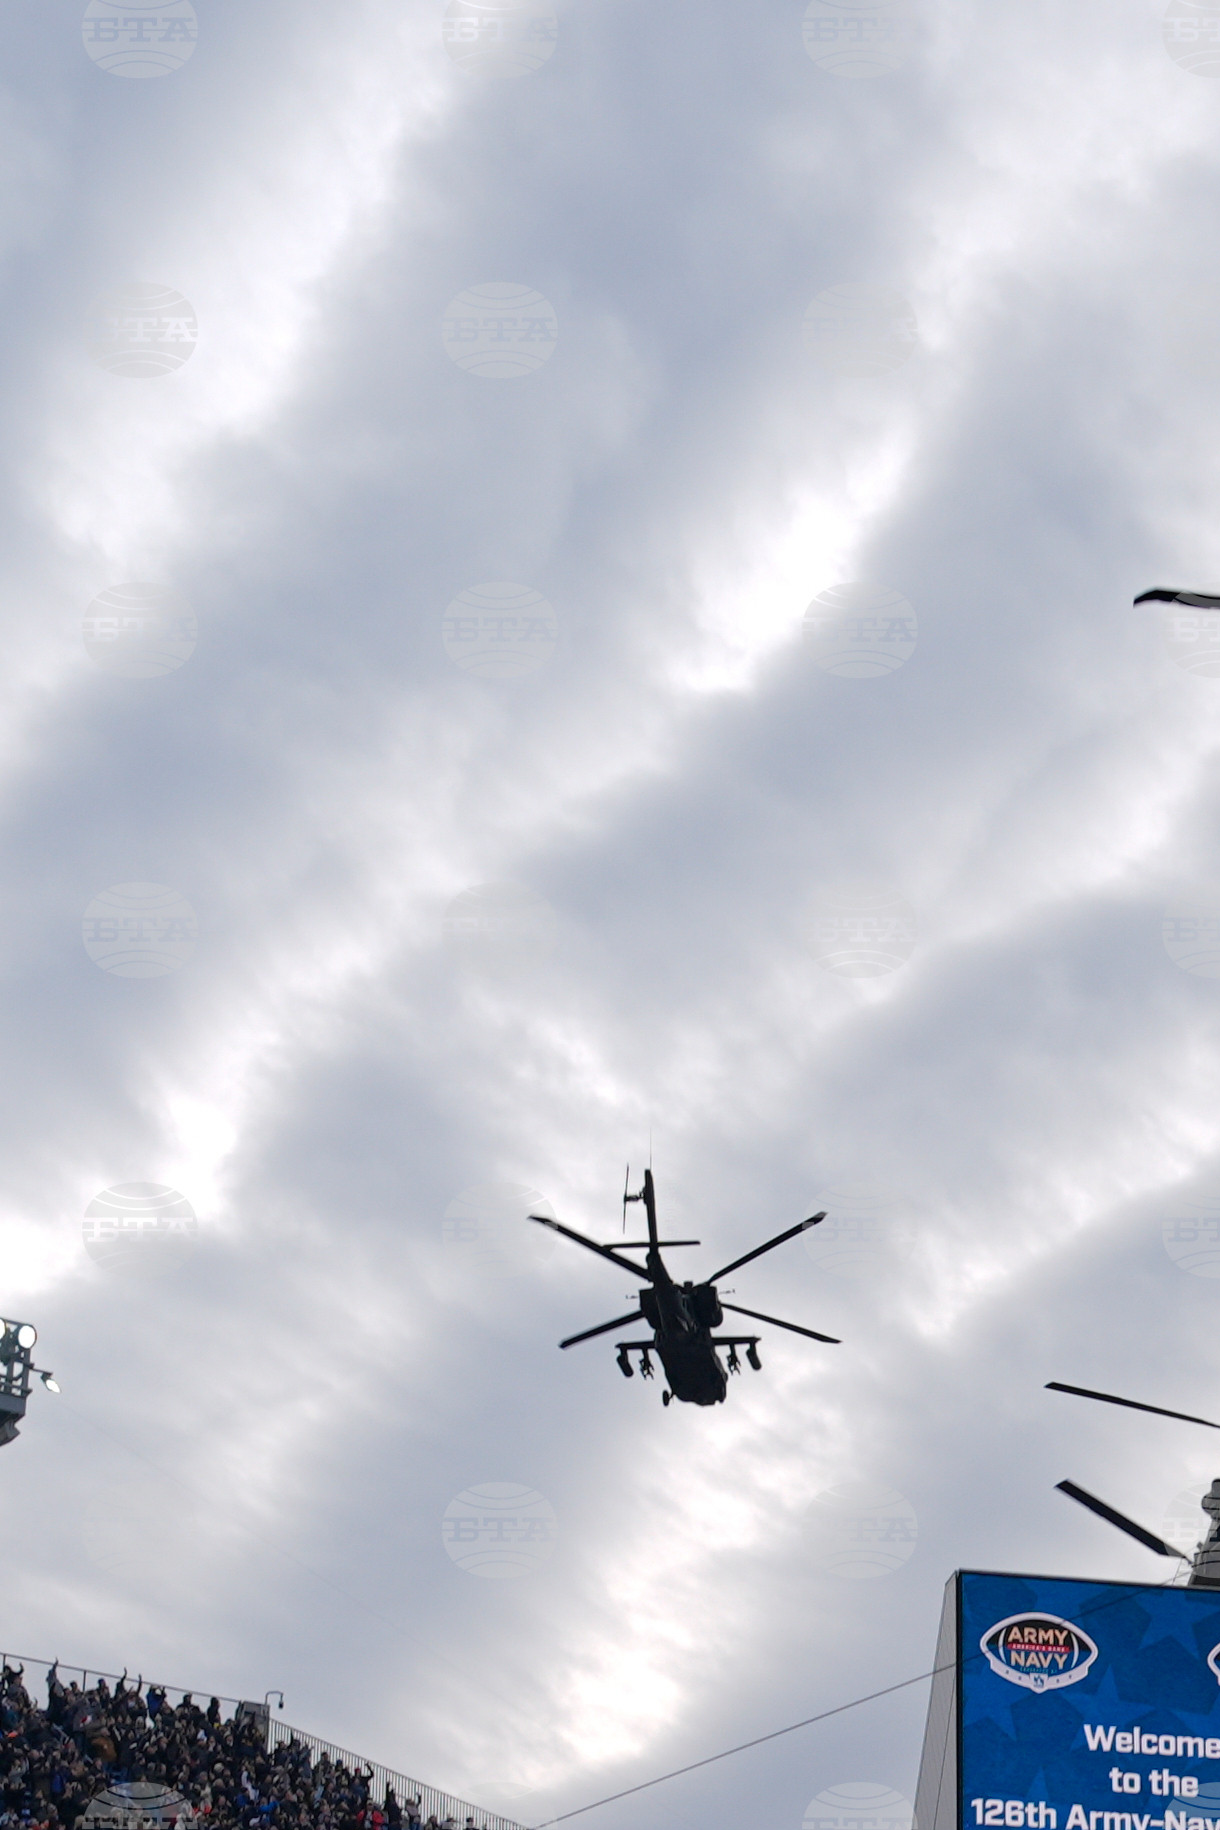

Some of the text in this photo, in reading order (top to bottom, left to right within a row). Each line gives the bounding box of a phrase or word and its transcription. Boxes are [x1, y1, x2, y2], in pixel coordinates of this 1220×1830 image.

[1008, 1626, 1068, 1645] ARMY
[1010, 1650, 1068, 1670] NAVY
[1109, 1767, 1199, 1798] to the
[971, 1797, 1057, 1830] 126th
